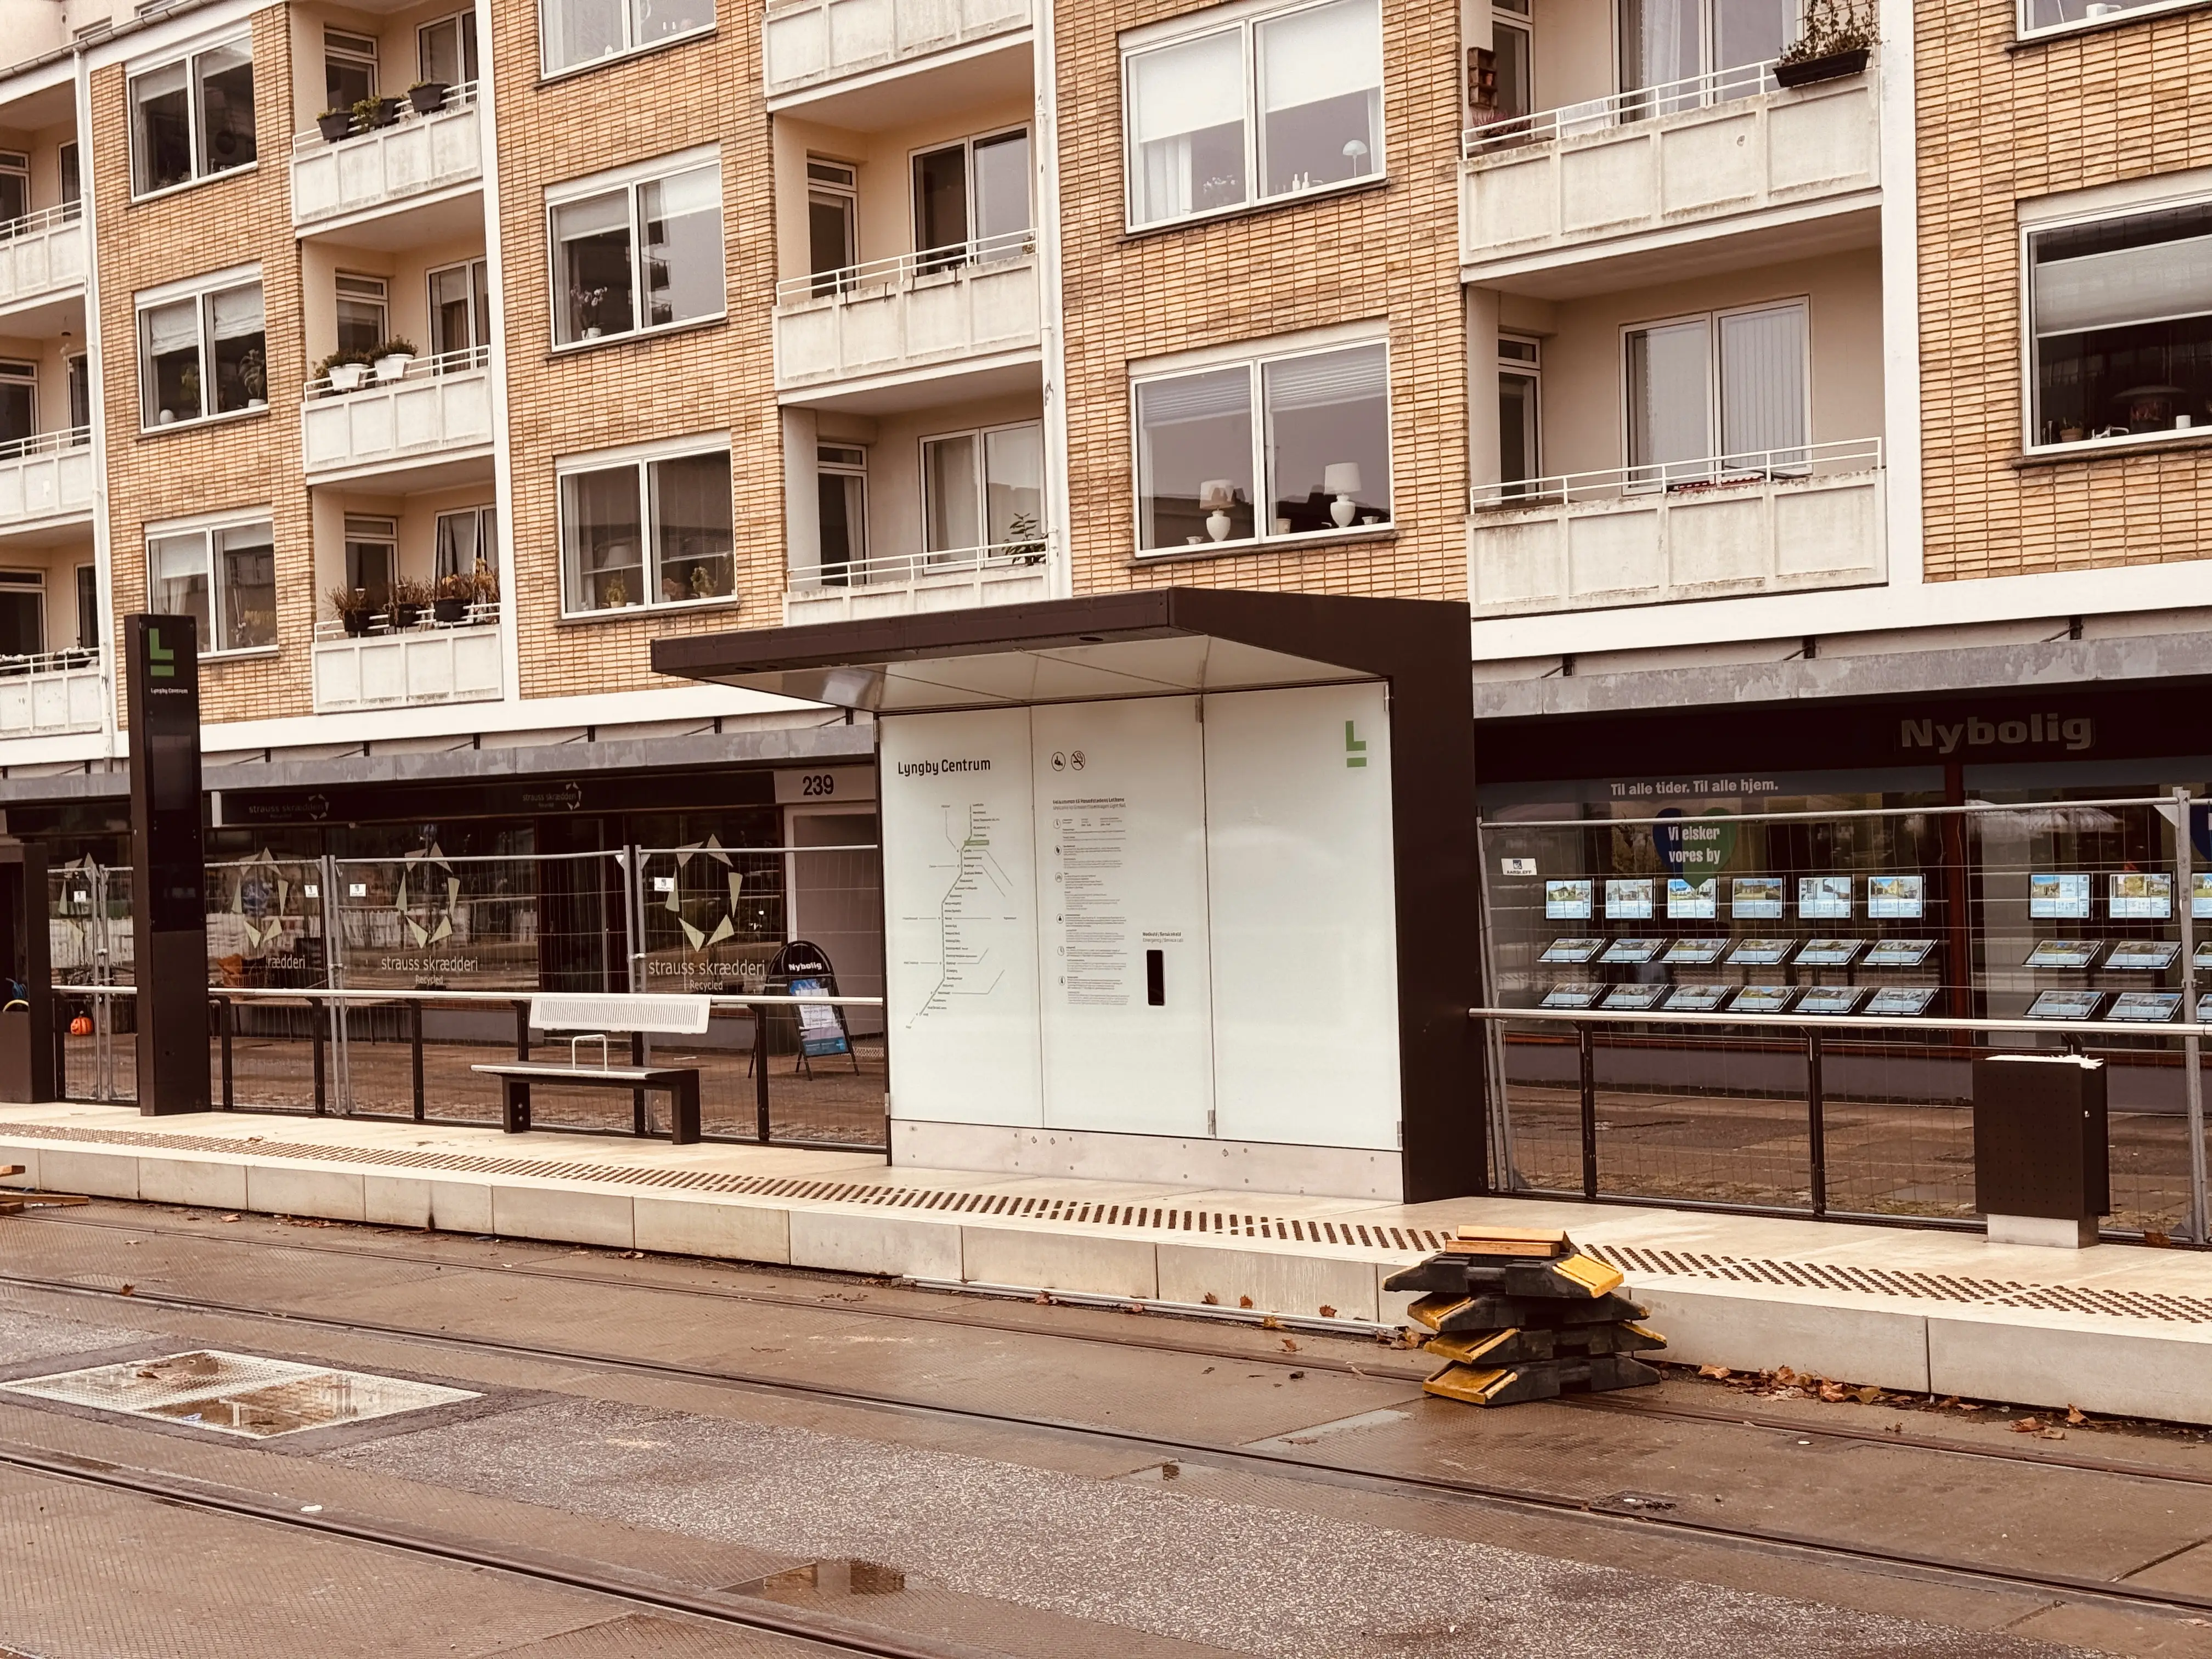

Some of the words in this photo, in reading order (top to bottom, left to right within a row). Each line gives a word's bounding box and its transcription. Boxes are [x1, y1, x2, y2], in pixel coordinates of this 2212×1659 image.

[1901, 713, 2092, 754] Nybolig
[898, 760, 939, 777] Lyngby
[941, 759, 991, 772] Centrum
[803, 774, 834, 795] 239
[1611, 783, 1626, 795] Til
[1628, 782, 1652, 795] alle
[1656, 781, 1690, 794] tider.
[1693, 780, 1708, 793] Til
[1712, 780, 1736, 792] alle
[1740, 778, 1779, 794] hjem.
[1668, 826, 1679, 841] Vi
[1682, 826, 1720, 840] elsker
[1669, 849, 1703, 863] vores
[1706, 848, 1720, 865] by
[266, 953, 306, 969] rædderi
[381, 956, 420, 971] strauss
[423, 955, 478, 972] skrædderi
[648, 959, 695, 975] strauss
[698, 958, 765, 976] skrædderi
[788, 962, 822, 972] Nybolig
[415, 974, 443, 986] Recycled
[690, 979, 724, 991] Recycled
